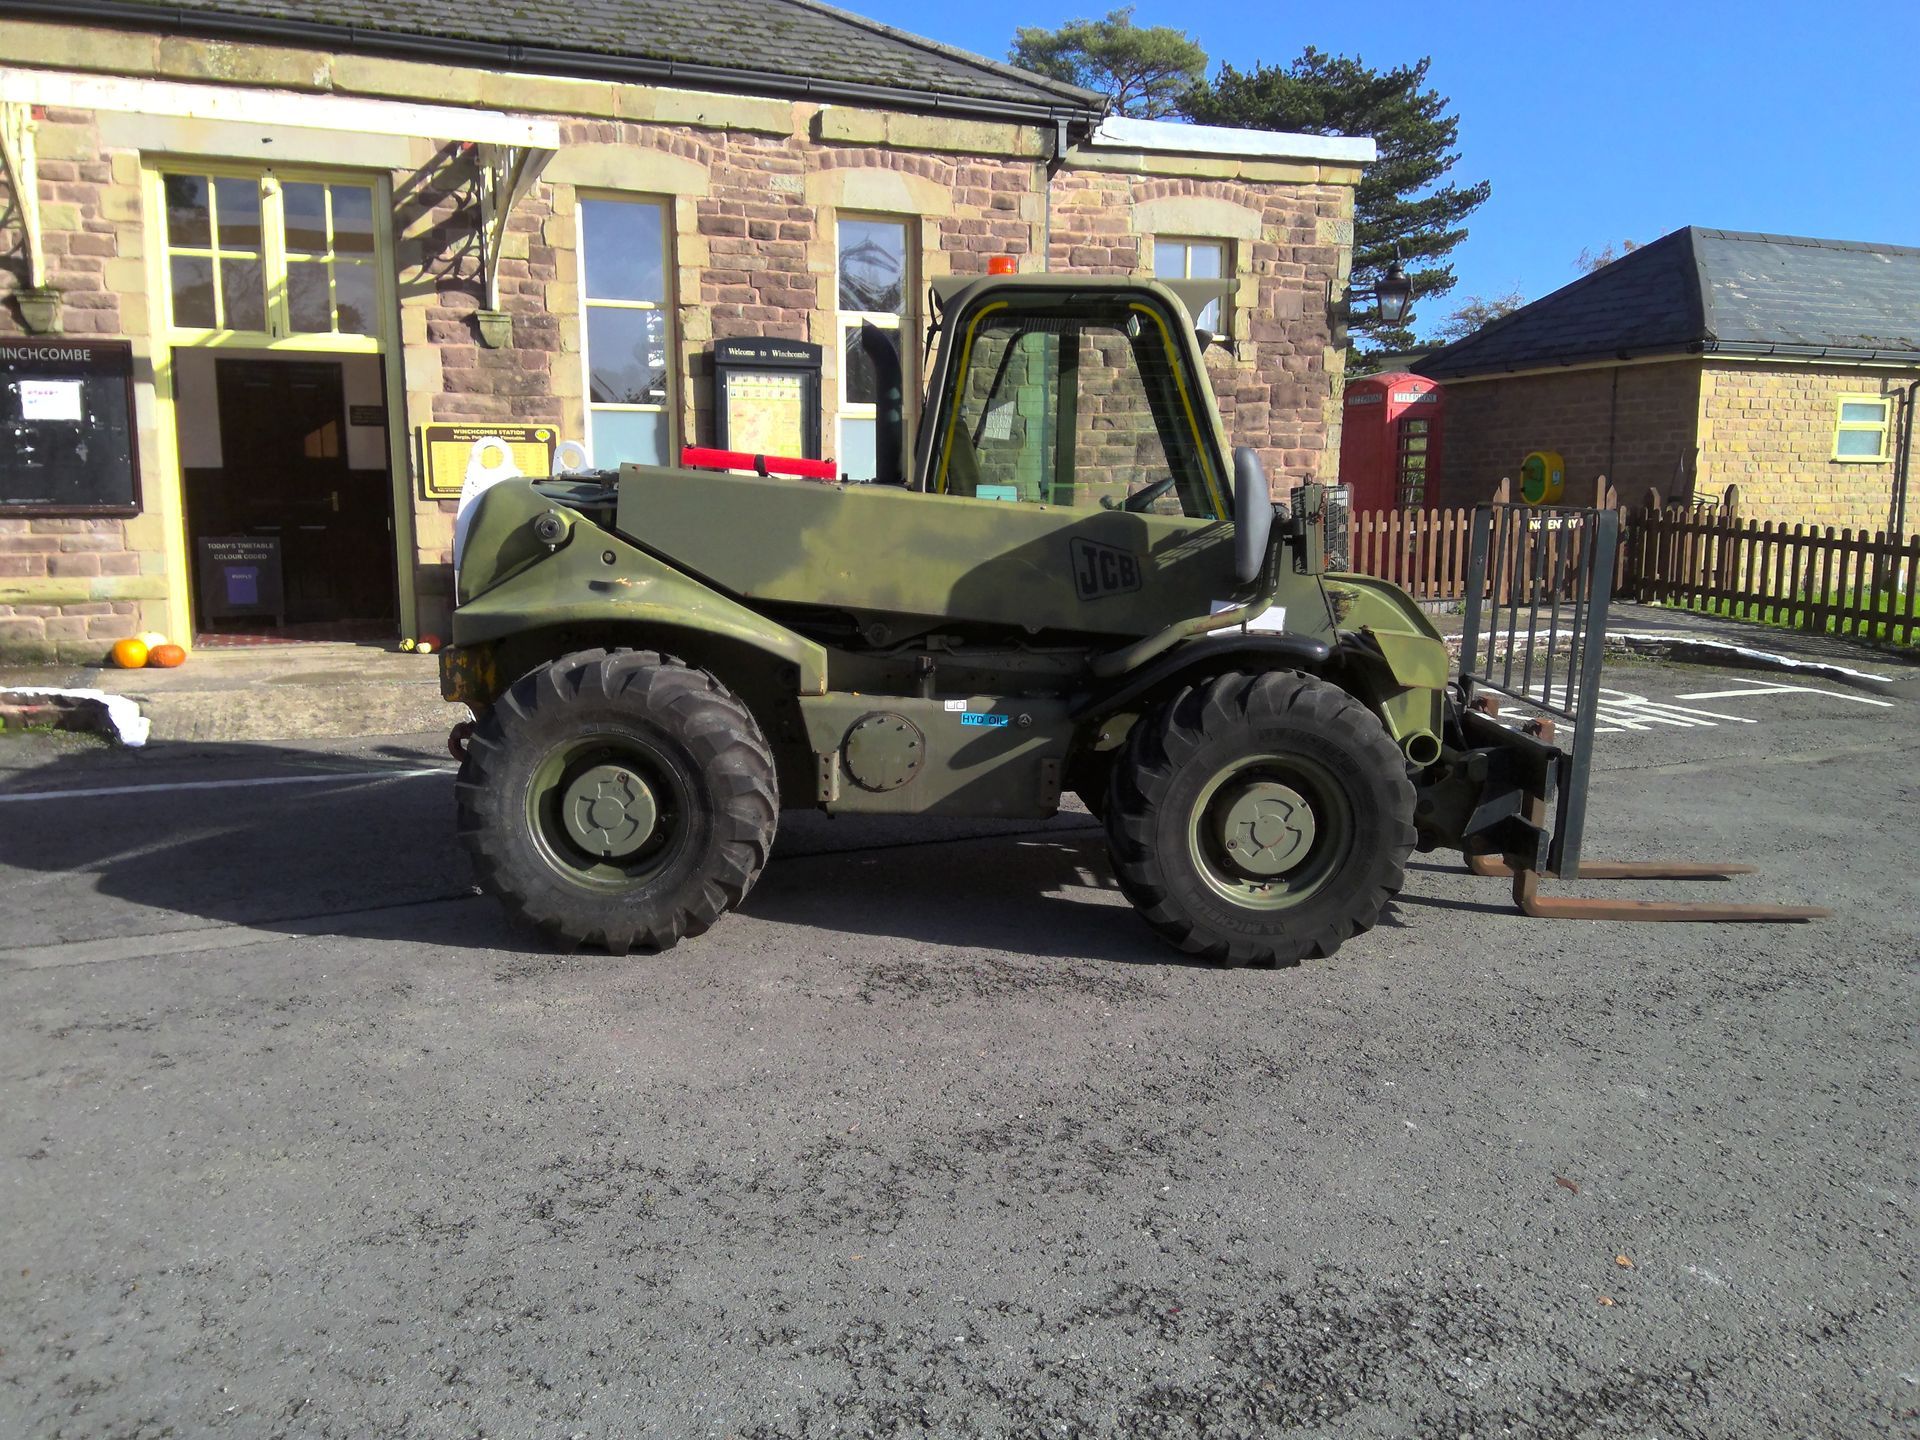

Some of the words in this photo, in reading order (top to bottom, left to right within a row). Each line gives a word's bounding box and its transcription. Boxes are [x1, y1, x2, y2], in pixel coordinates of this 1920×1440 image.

[0, 347, 91, 361] INCHCOMBE
[728, 347, 756, 356] Welcome
[772, 349, 810, 359] Winchcombe
[1547, 518, 1579, 530] ENY
[1079, 545, 1137, 595] JCB
[962, 713, 984, 724] HYD
[988, 715, 1008, 725] OIL
